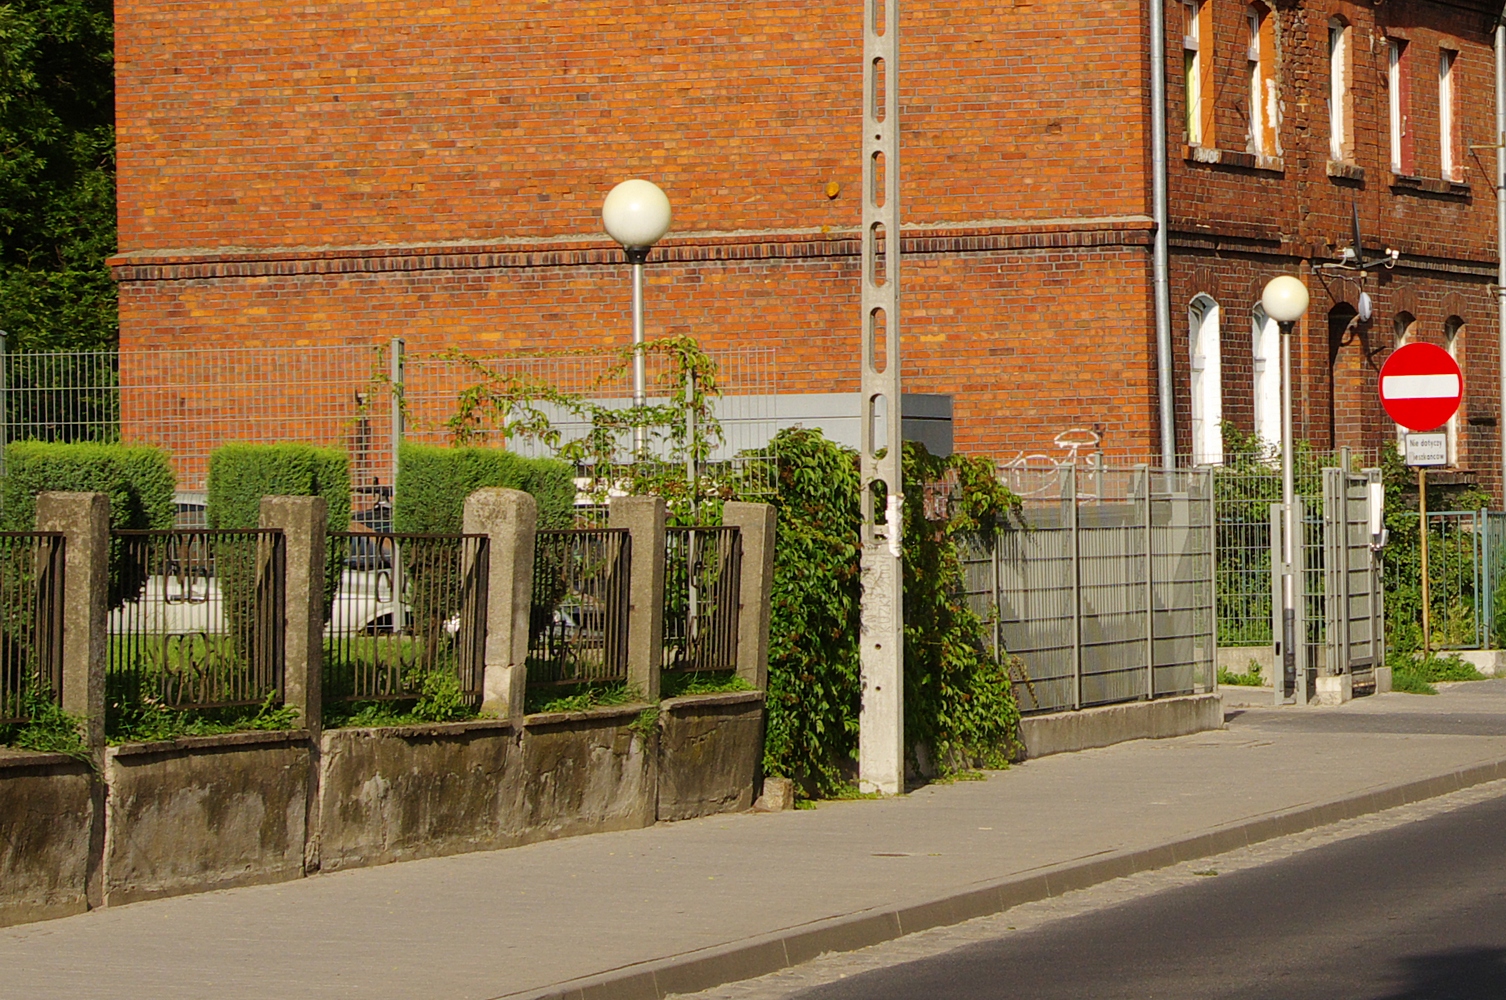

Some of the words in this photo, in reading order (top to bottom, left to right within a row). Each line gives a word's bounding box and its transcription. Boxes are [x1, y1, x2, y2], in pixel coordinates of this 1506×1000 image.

[1409, 439, 1419, 447] Nie
[1421, 439, 1442, 449] dotyczy
[1409, 452, 1444, 461] ieszkańców
